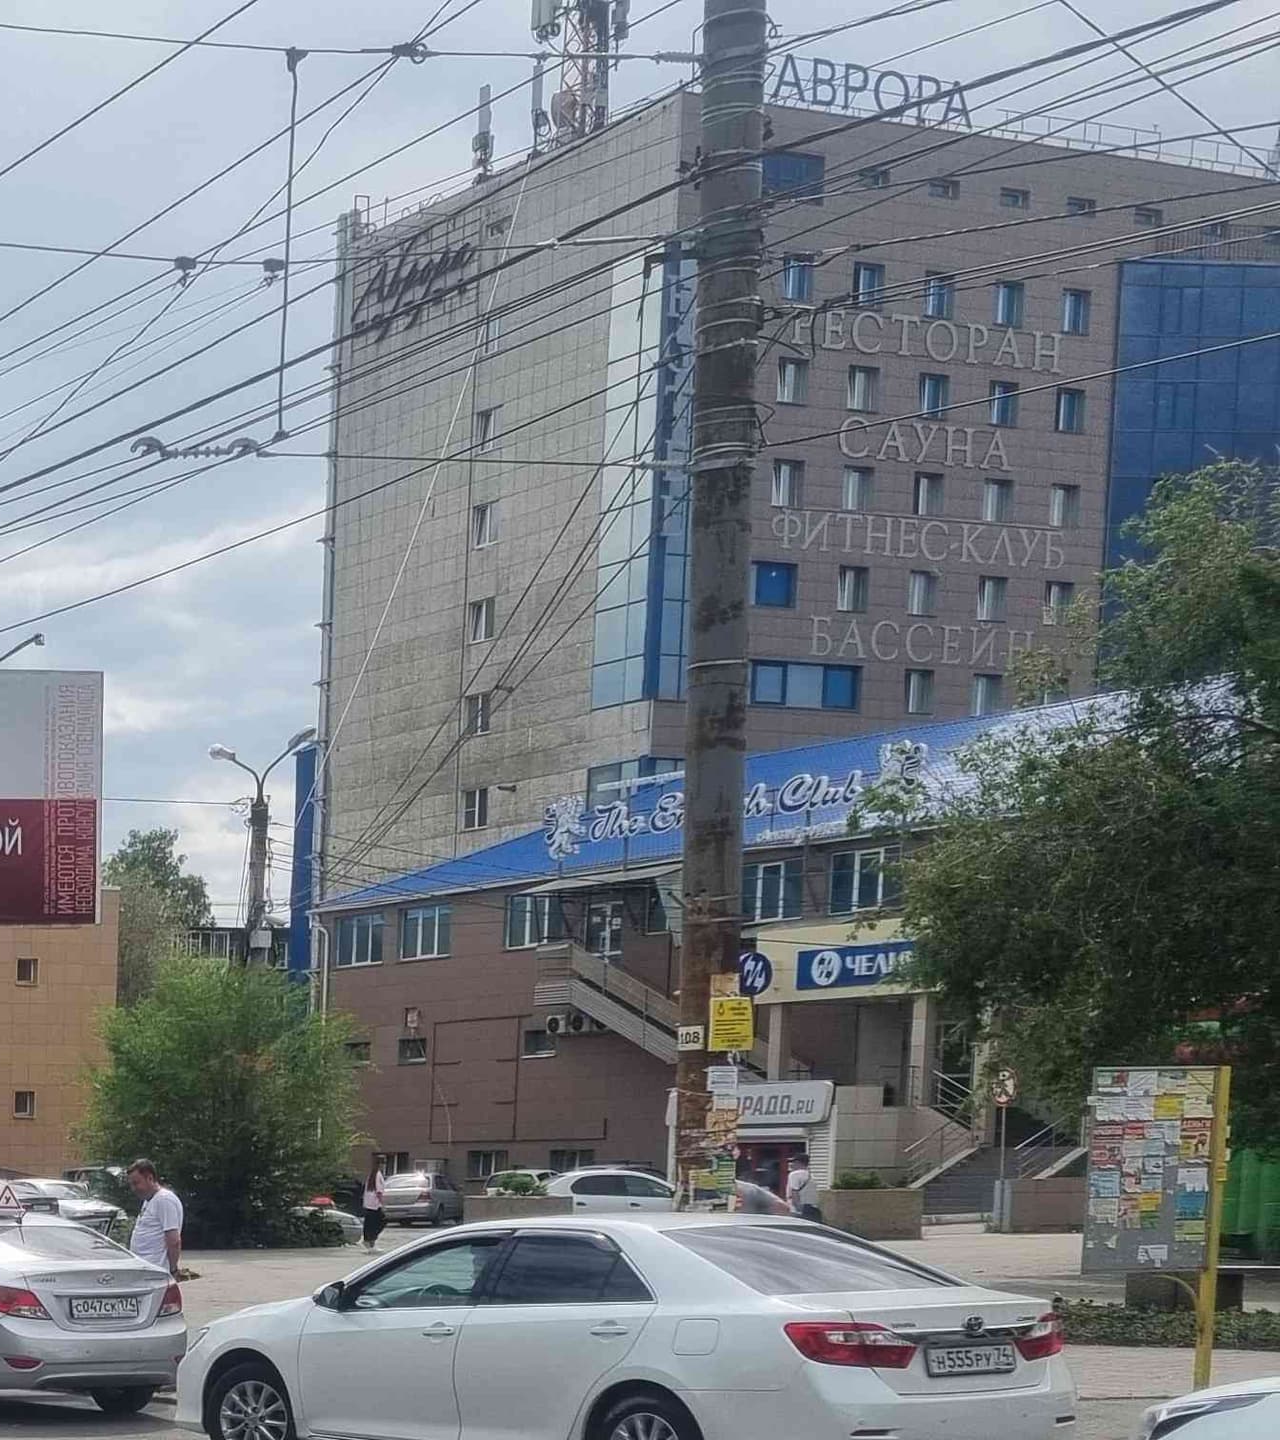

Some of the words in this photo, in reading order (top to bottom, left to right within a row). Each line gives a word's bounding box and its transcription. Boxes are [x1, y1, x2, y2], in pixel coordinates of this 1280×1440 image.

[771, 53, 973, 129] АВРОРА
[787, 304, 1063, 374] РЕСТОРАН
[838, 417, 1013, 471] САУНА
[771, 507, 1066, 570] ФИТНЕС-КЛУБ
[57, 684, 75, 836] ПРОТИВОПОКАЗАНИЯ
[590, 801, 643, 843] The
[778, 770, 862, 814] Club
[57, 844, 75, 914] ИМЕЮТСЯ
[75, 845, 94, 914] НЕОБХОДИМА
[936, 1350, 992, 1369] Н555РУ
